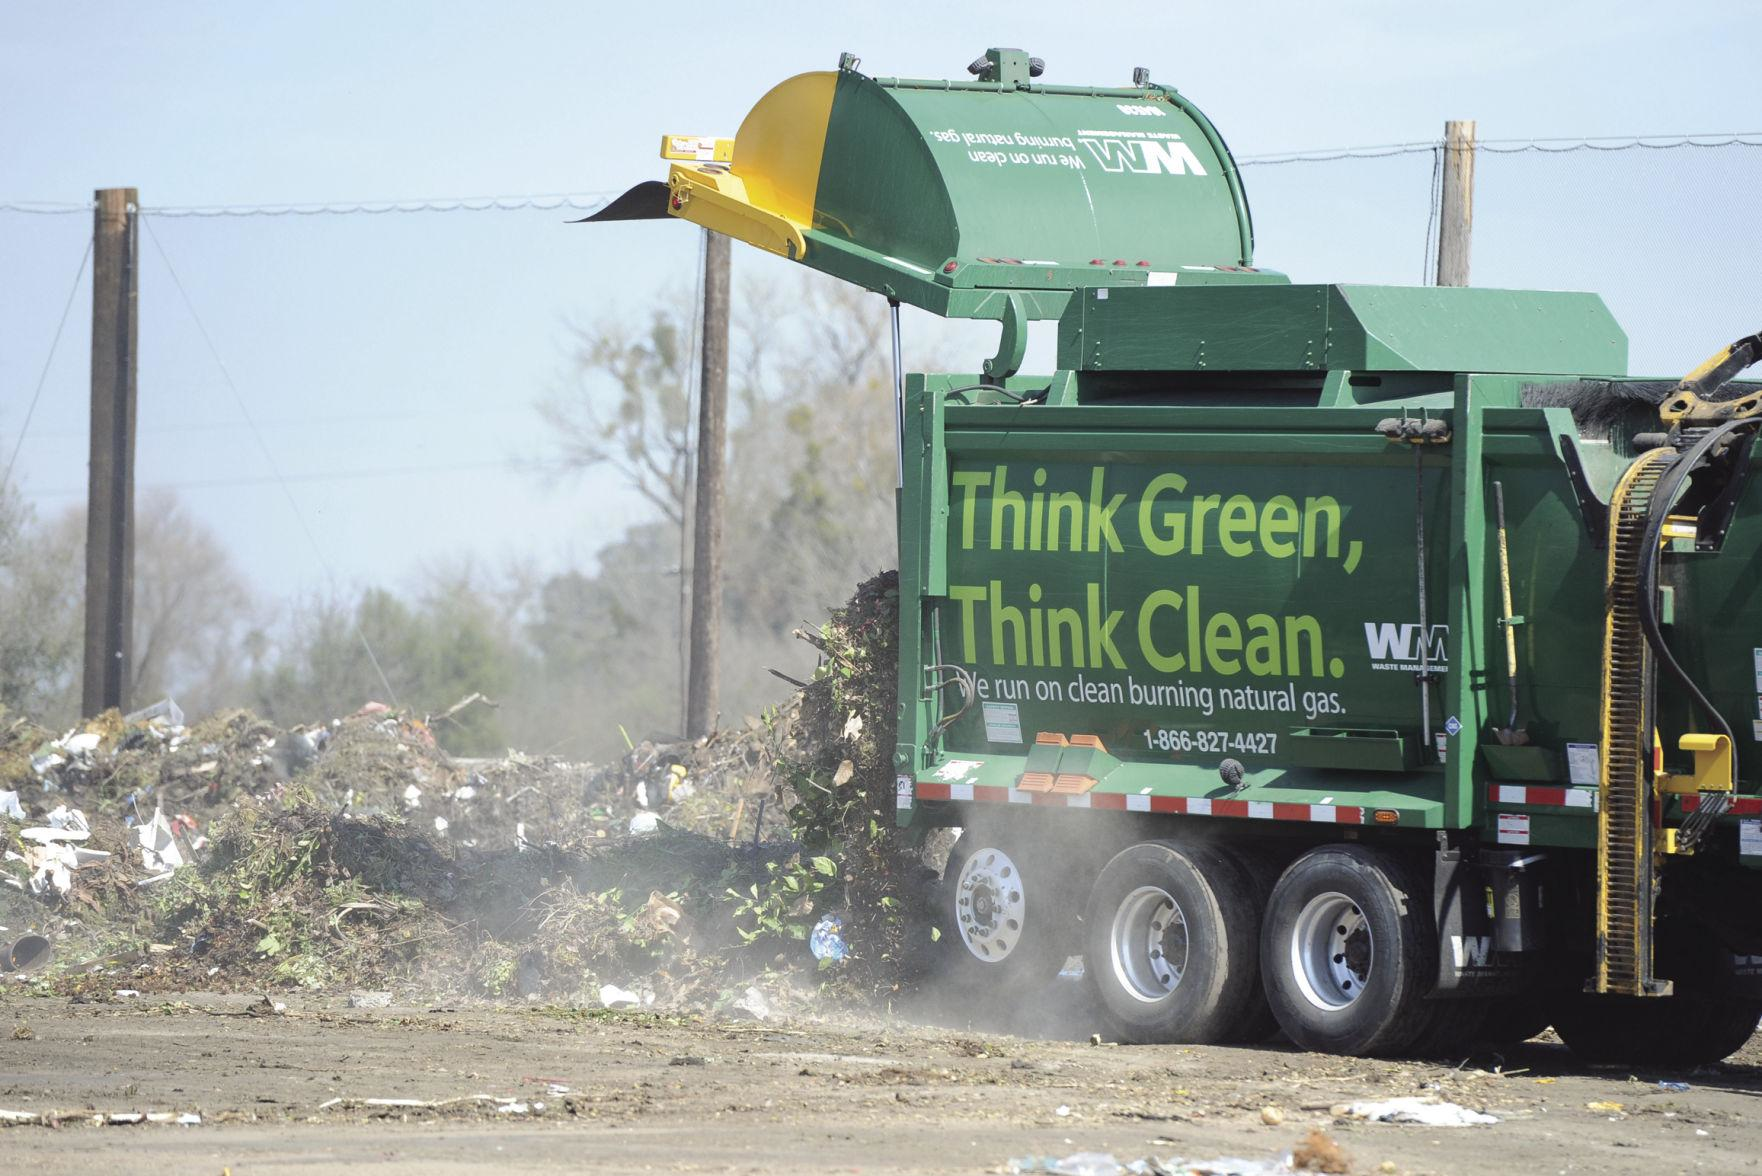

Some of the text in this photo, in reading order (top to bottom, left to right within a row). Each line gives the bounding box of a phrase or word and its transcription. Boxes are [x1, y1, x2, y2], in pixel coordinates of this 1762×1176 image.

[929, 129, 1076, 151] burning natural gas.
[1078, 138, 1208, 176] WM
[968, 151, 1086, 170] We run on clean
[952, 465, 1363, 575] Think Green,
[949, 579, 1345, 679] Think Clean.
[1364, 622, 1450, 662] WM
[1371, 663, 1399, 671] WASTE
[995, 678, 1030, 700] run
[1035, 680, 1063, 702] on
[1068, 673, 1124, 704] clean
[1128, 675, 1214, 717] burning
[1219, 682, 1297, 712] natural
[1302, 690, 1347, 720] gas.
[1143, 729, 1278, 754] 1-866-827-4427
